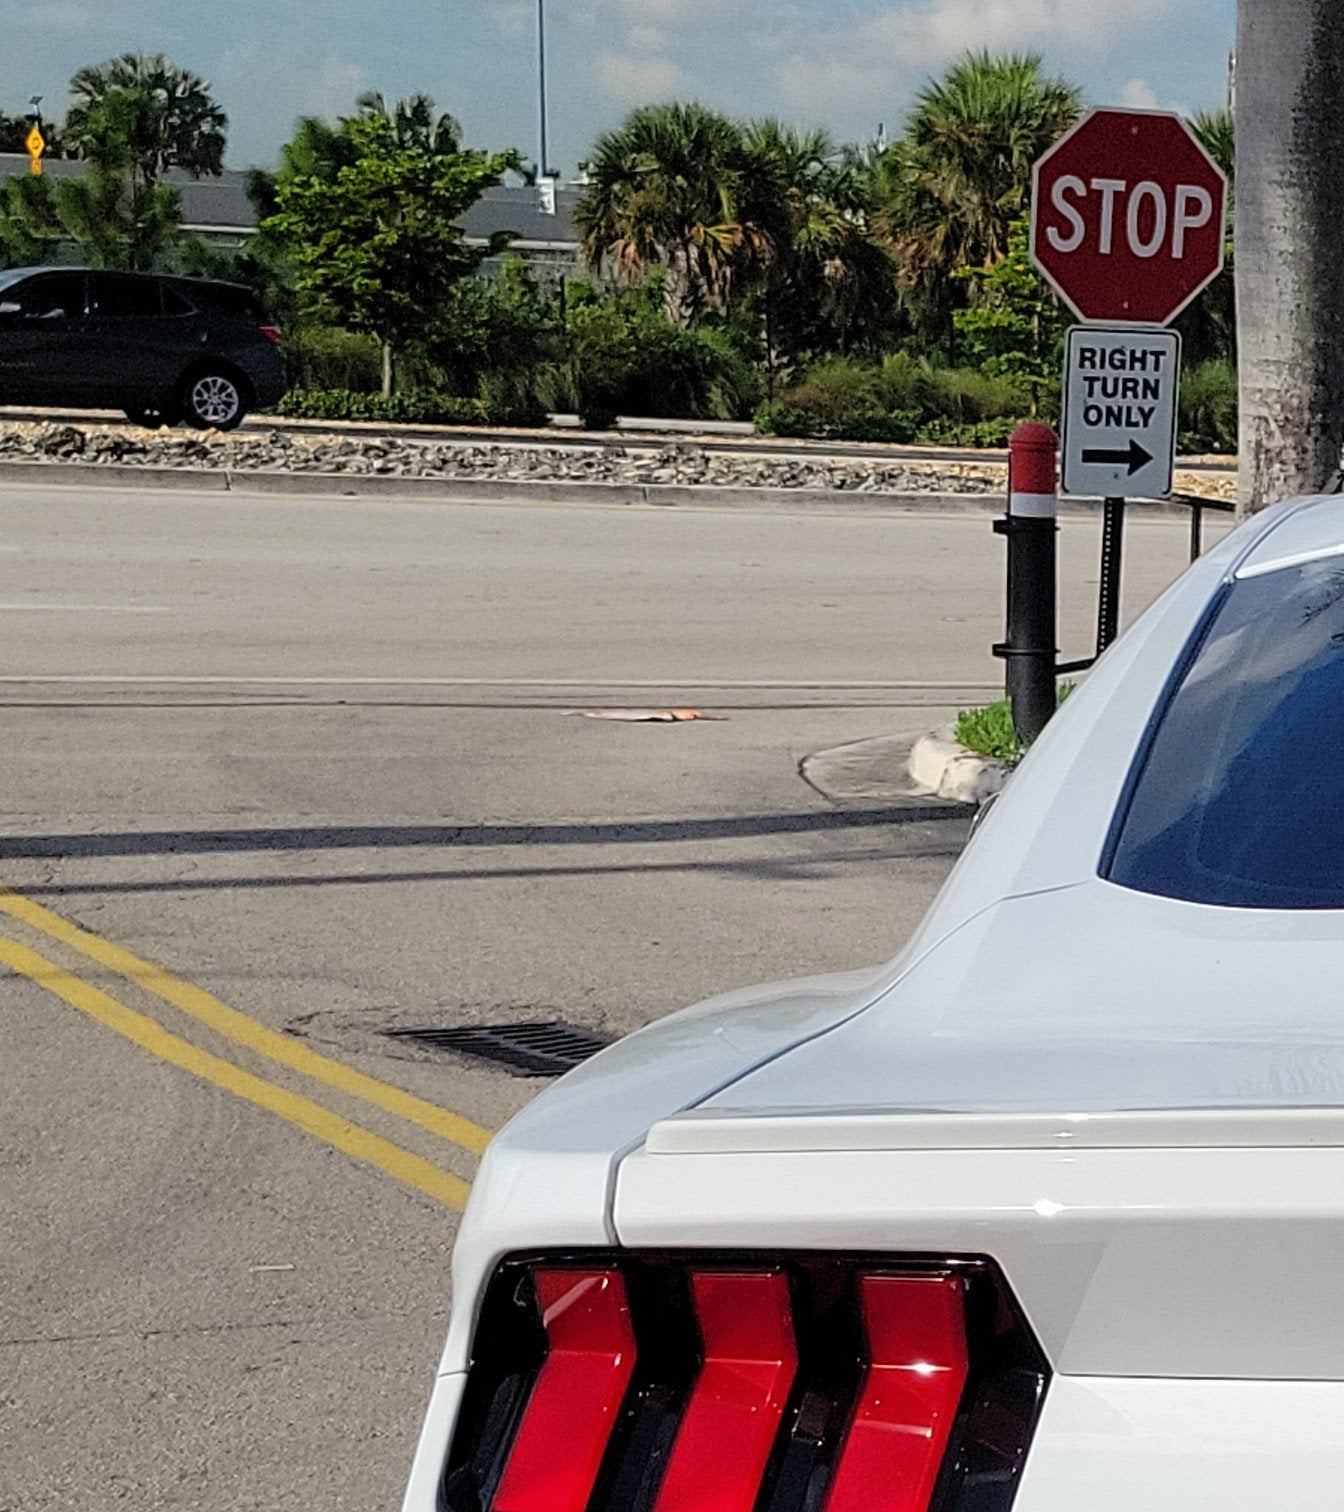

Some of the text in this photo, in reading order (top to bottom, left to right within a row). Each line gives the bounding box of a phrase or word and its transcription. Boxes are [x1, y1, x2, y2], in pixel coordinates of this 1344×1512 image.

[1046, 175, 1213, 259] STOP
[1078, 347, 1167, 372] RIGHT
[1083, 376, 1160, 400] TURN
[1083, 404, 1156, 429] ONLY
